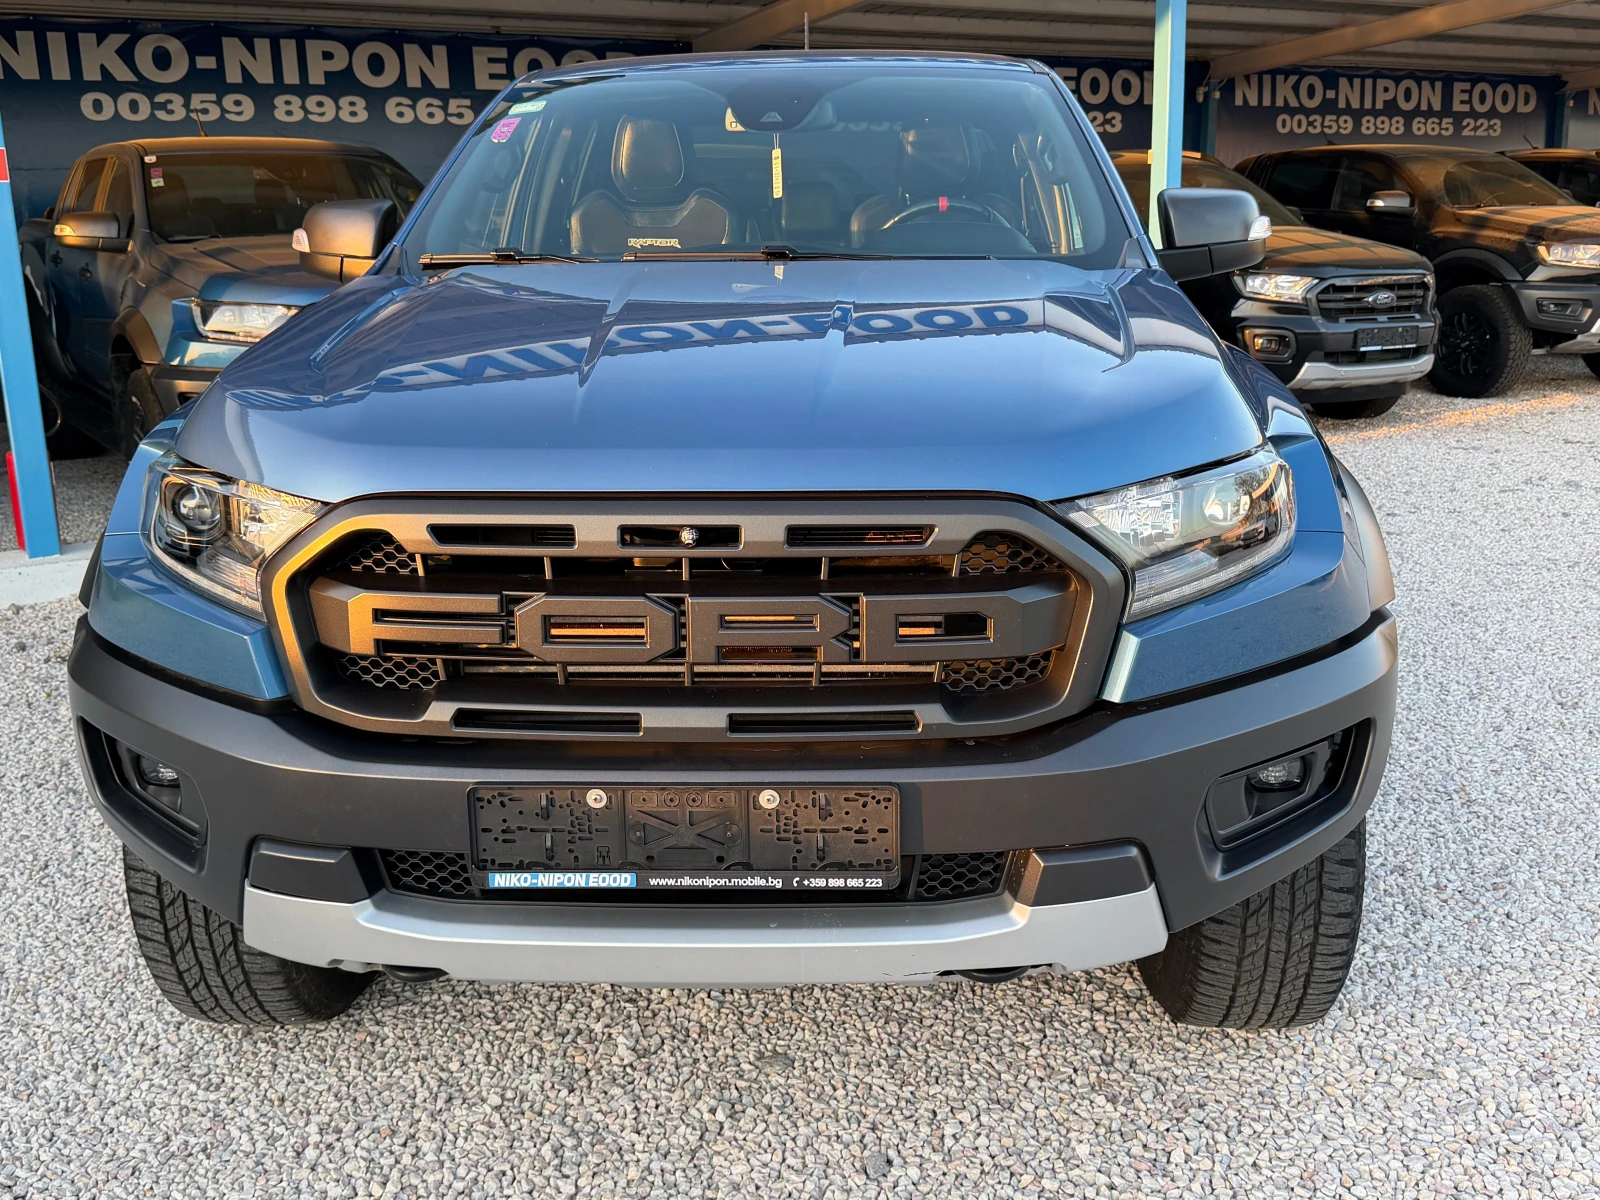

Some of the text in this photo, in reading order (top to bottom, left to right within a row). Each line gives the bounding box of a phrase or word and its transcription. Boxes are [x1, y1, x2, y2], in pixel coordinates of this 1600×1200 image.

[0, 30, 451, 90] NIKO-NIPON
[80, 91, 255, 122] 00359
[273, 94, 369, 124] 898
[385, 96, 475, 125] 665
[1234, 73, 1537, 113] NIKO-NIPON EOOD
[1276, 114, 1502, 137] 00359 898 665 223
[627, 238, 682, 249] RAPTOR
[340, 590, 1040, 665] FORD
[494, 872, 883, 889] NIKO-NIPON EOOD www.nikonipon.mobile.bg +359 898 665 223
